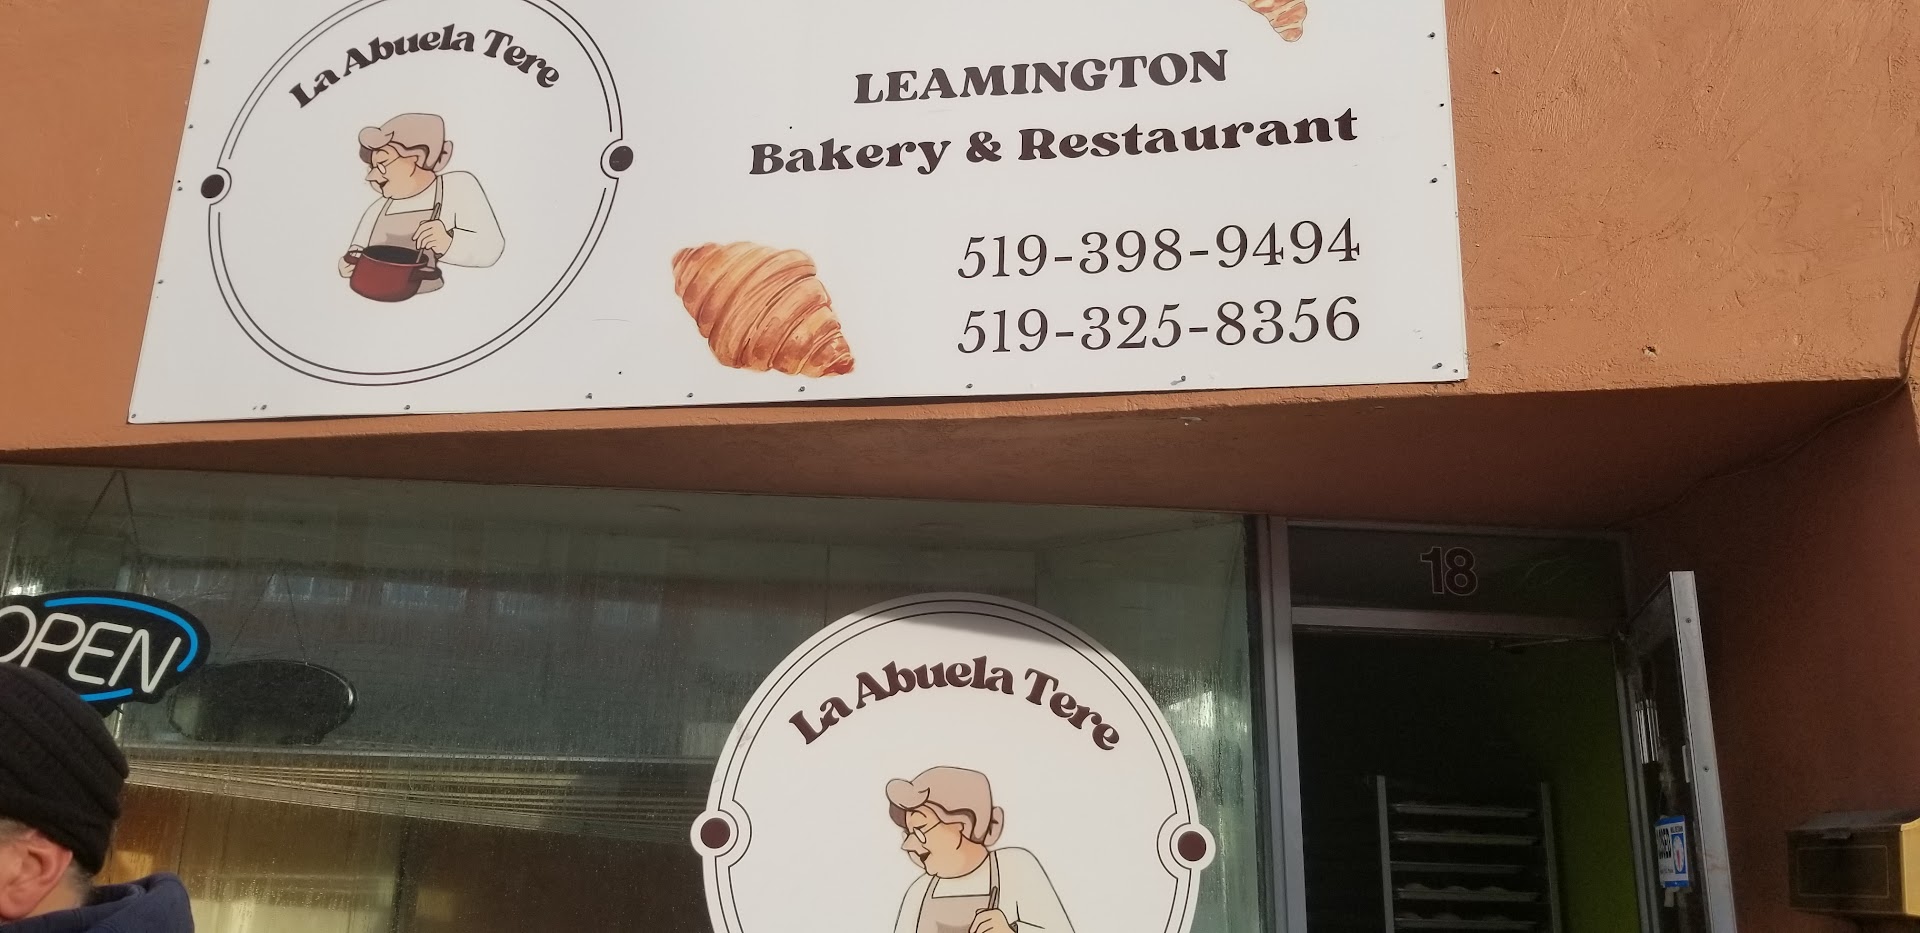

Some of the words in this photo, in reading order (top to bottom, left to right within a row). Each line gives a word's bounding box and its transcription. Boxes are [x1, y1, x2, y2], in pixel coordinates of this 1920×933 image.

[289, 70, 341, 109] La
[343, 23, 475, 77] Abuela
[483, 29, 560, 89] Tere
[854, 49, 1229, 104] LEAMINGTON
[749, 137, 952, 175] Bakery
[965, 131, 1002, 163] &
[1018, 107, 1358, 161] Restaurant
[957, 217, 1360, 279] 519-398-9494
[957, 295, 1360, 354] 519-325-8356
[1420, 546, 1478, 596] 18
[0, 604, 182, 694] OPEN
[788, 697, 853, 745] La
[856, 655, 1014, 709] Abuela
[1024, 668, 1120, 751] Tere
